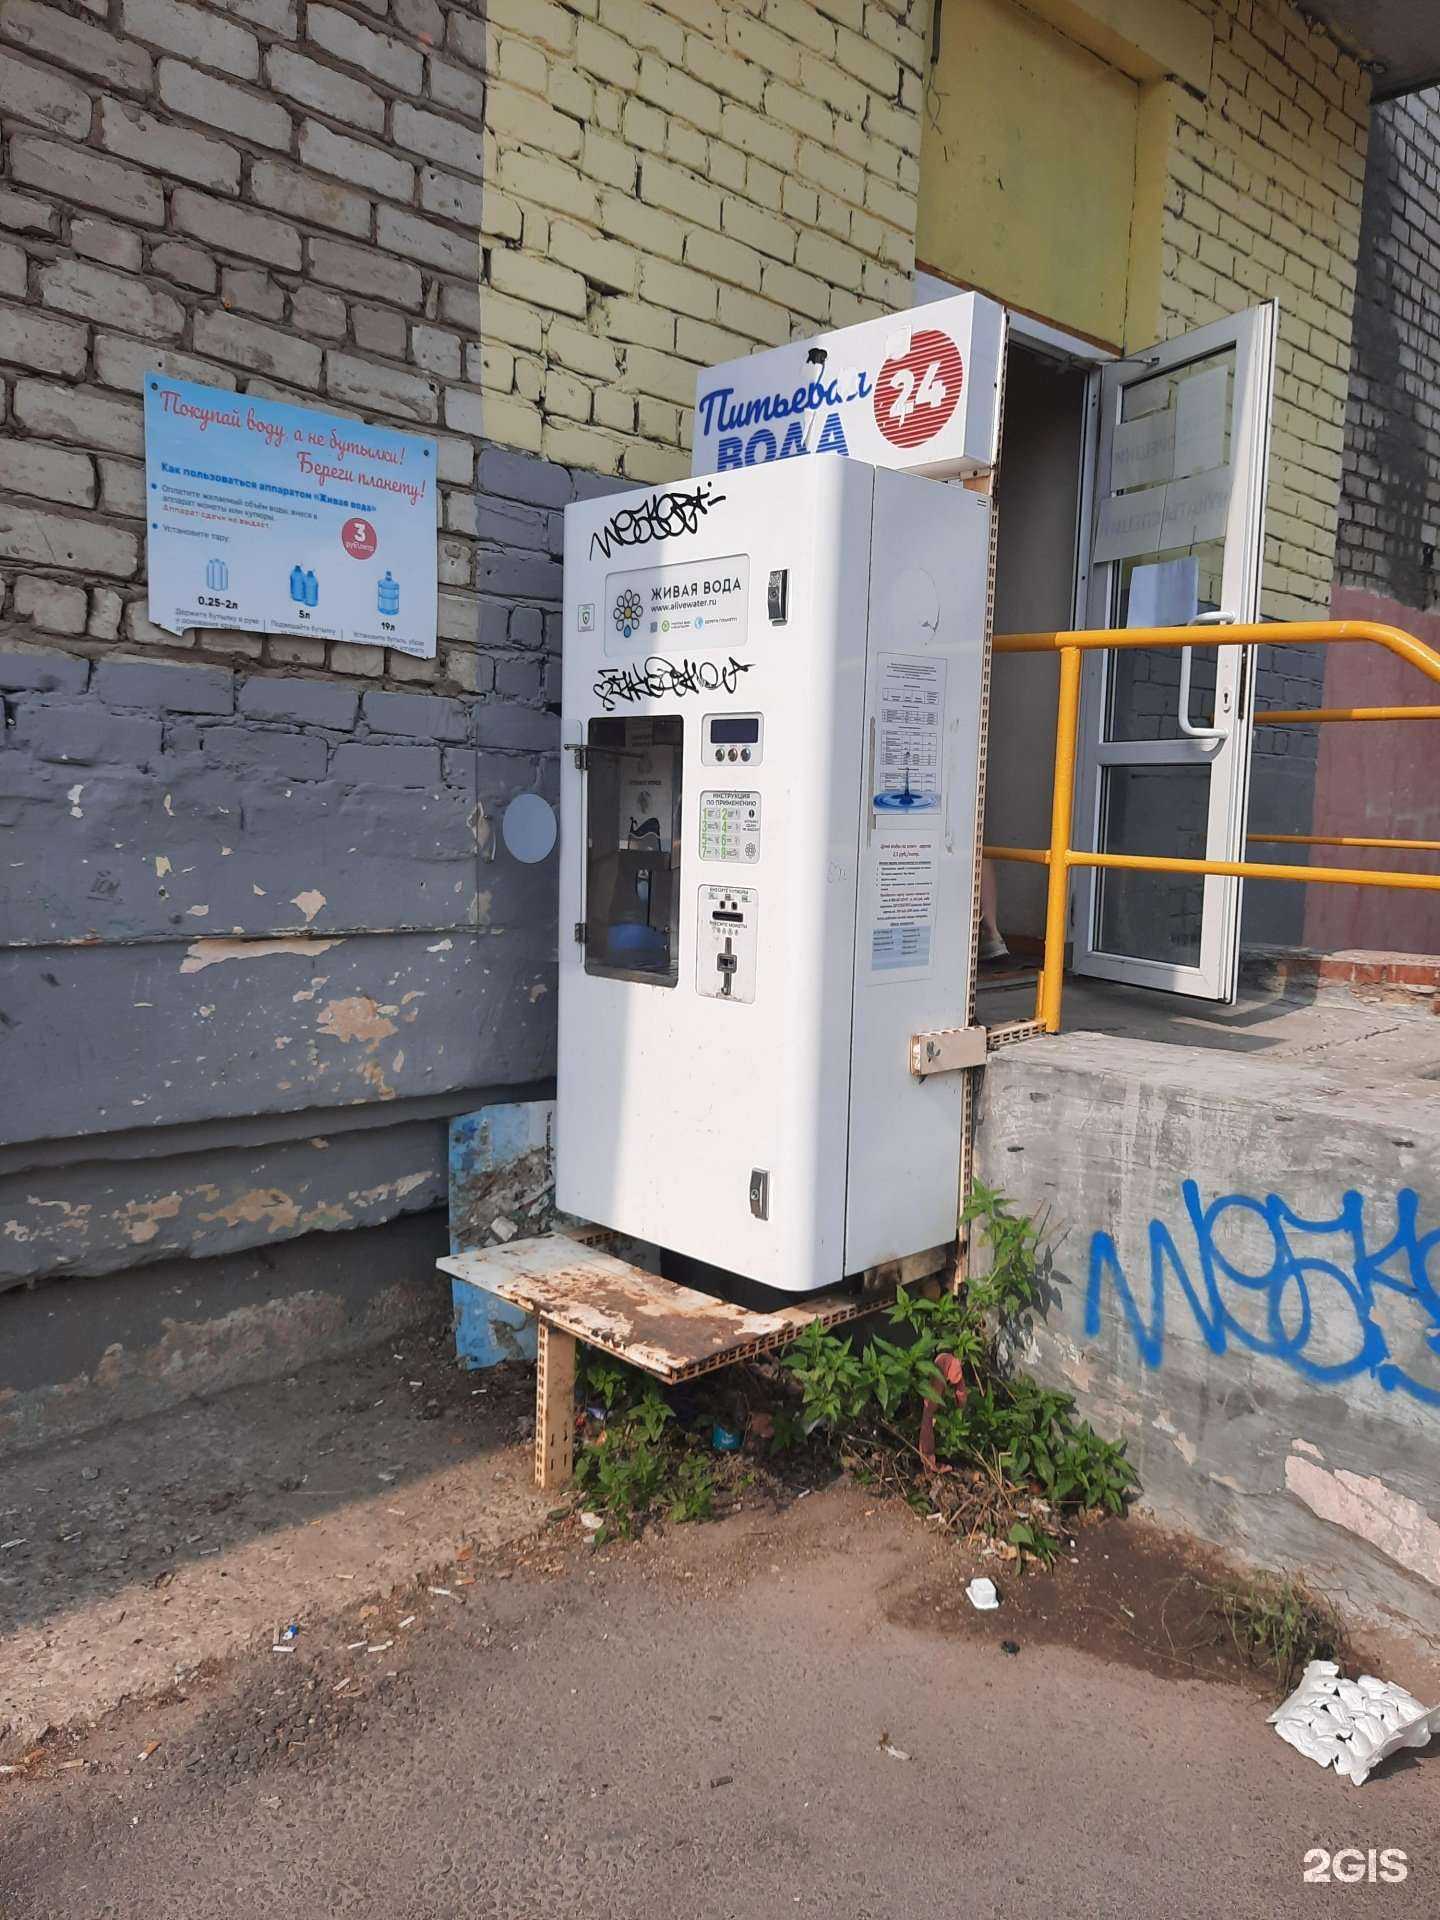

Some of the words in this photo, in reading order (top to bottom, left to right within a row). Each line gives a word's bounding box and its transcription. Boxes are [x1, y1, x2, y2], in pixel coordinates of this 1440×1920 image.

[886, 362, 948, 419] 24
[160, 390, 241, 431] Покупай
[294, 429, 303, 442] а
[308, 431, 325, 446] не
[329, 428, 405, 464] бутылки!
[161, 462, 181, 475] Как
[182, 467, 257, 489] пользоваться
[259, 481, 312, 500] аппаратом
[297, 451, 353, 486] Береги
[358, 473, 426, 505] планету!
[353, 522, 366, 543] 3
[651, 583, 698, 601] ЖИВАЯ
[703, 577, 741, 595] ВОДА
[198, 595, 239, 610] 0.25-2л
[651, 599, 717, 613] www.alivewater.ru
[298, 609, 311, 620] 5л
[380, 621, 396, 633] 19л
